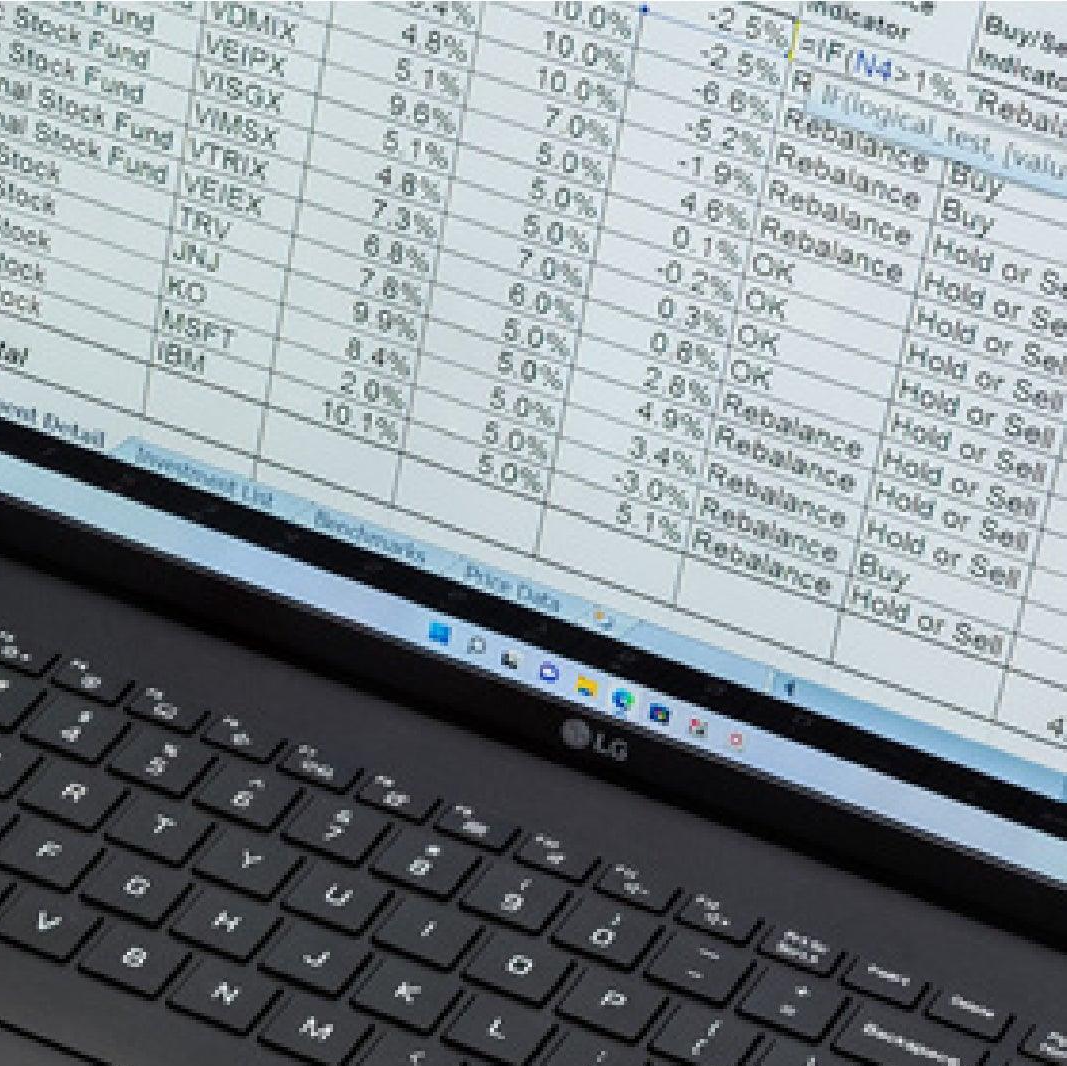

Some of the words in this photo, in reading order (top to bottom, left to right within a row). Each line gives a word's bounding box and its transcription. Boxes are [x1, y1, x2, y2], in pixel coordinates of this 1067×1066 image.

[12, 5, 82, 45] Stock
[88, 30, 151, 70] Fund
[8, 41, 76, 81] Stock
[83, 65, 145, 105] Fund
[38, 86, 106, 128] Stock
[113, 111, 175, 151] Fund
[784, 106, 930, 174] Rebalance
[33, 121, 102, 161] Stock
[107, 146, 169, 185] Fund
[775, 142, 922, 212] Rebalance
[948, 161, 1005, 204] Buy
[178, 205, 231, 240] TRV
[767, 179, 914, 247] Rebalance
[940, 197, 996, 240] Buy
[171, 240, 221, 273] JNJ
[751, 251, 796, 285] OK
[759, 215, 906, 285] Rebalance
[932, 233, 996, 275] Hold
[1001, 263, 1033, 285] or
[167, 274, 207, 303] KO
[744, 287, 788, 323] OK
[923, 270, 987, 311] Hold
[993, 298, 1025, 320] or
[161, 308, 237, 349] MSFT
[736, 323, 781, 357] OK
[917, 304, 980, 345] Hold
[984, 335, 1014, 358] or
[156, 340, 208, 374] IBM
[729, 358, 774, 391] OK
[907, 343, 969, 381] Hold
[974, 370, 1007, 392] or
[722, 392, 865, 461] Rebalance
[898, 377, 962, 417] Hold
[965, 406, 998, 427] or
[713, 424, 858, 494] Rebalance
[891, 413, 953, 453] Hold
[958, 442, 988, 463] or
[706, 461, 848, 529] Rebalance
[882, 450, 944, 487] Hold
[950, 476, 980, 498] or
[698, 495, 840, 564] Rebalance
[875, 481, 936, 521] Hold
[941, 511, 972, 532] or
[690, 529, 832, 597] Rebalance
[867, 518, 927, 556] Hold
[933, 546, 963, 566] or
[858, 552, 912, 593] Buy
[850, 585, 911, 624] Hold
[916, 614, 946, 635] or
[952, 620, 1006, 658] Sell
[593, 732, 630, 763] LG
